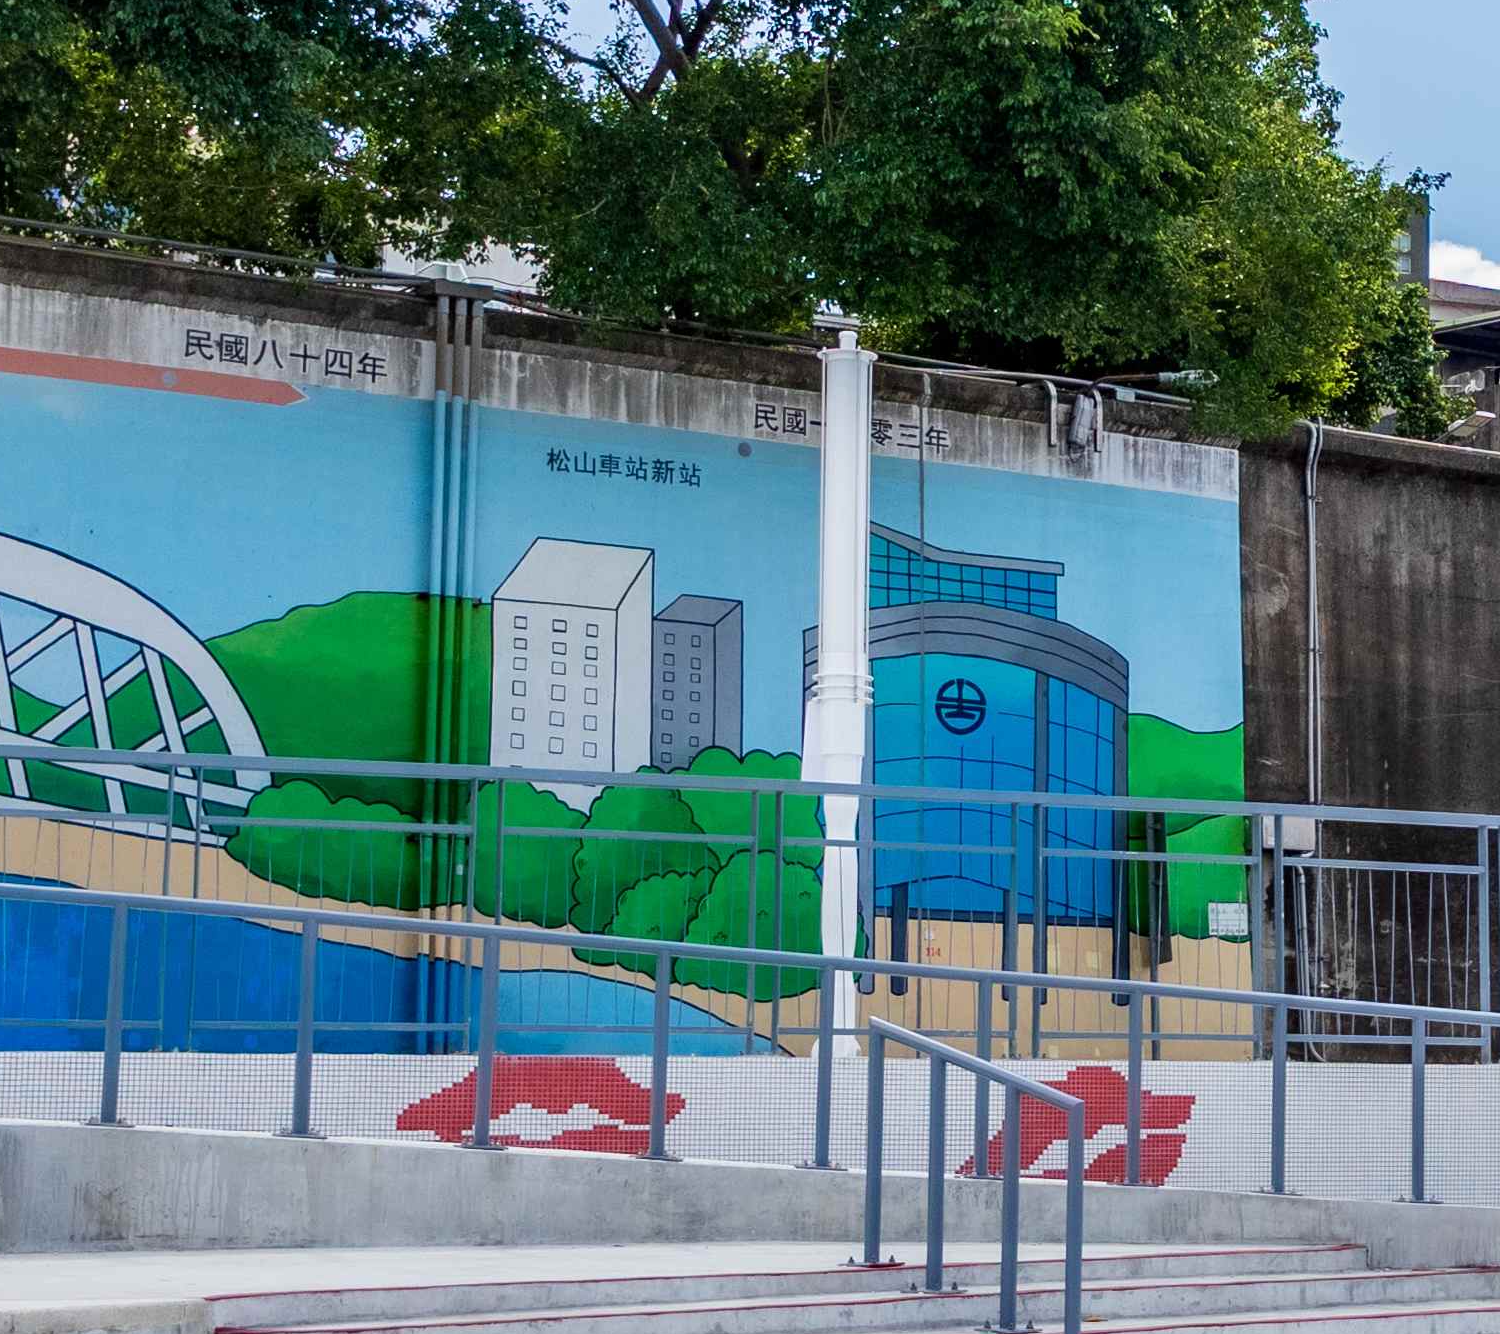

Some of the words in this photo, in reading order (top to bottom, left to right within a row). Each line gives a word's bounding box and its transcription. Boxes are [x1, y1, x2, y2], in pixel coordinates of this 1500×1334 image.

[184, 329, 388, 383] 民國八十四年
[547, 448, 702, 487] 松山車站新站
